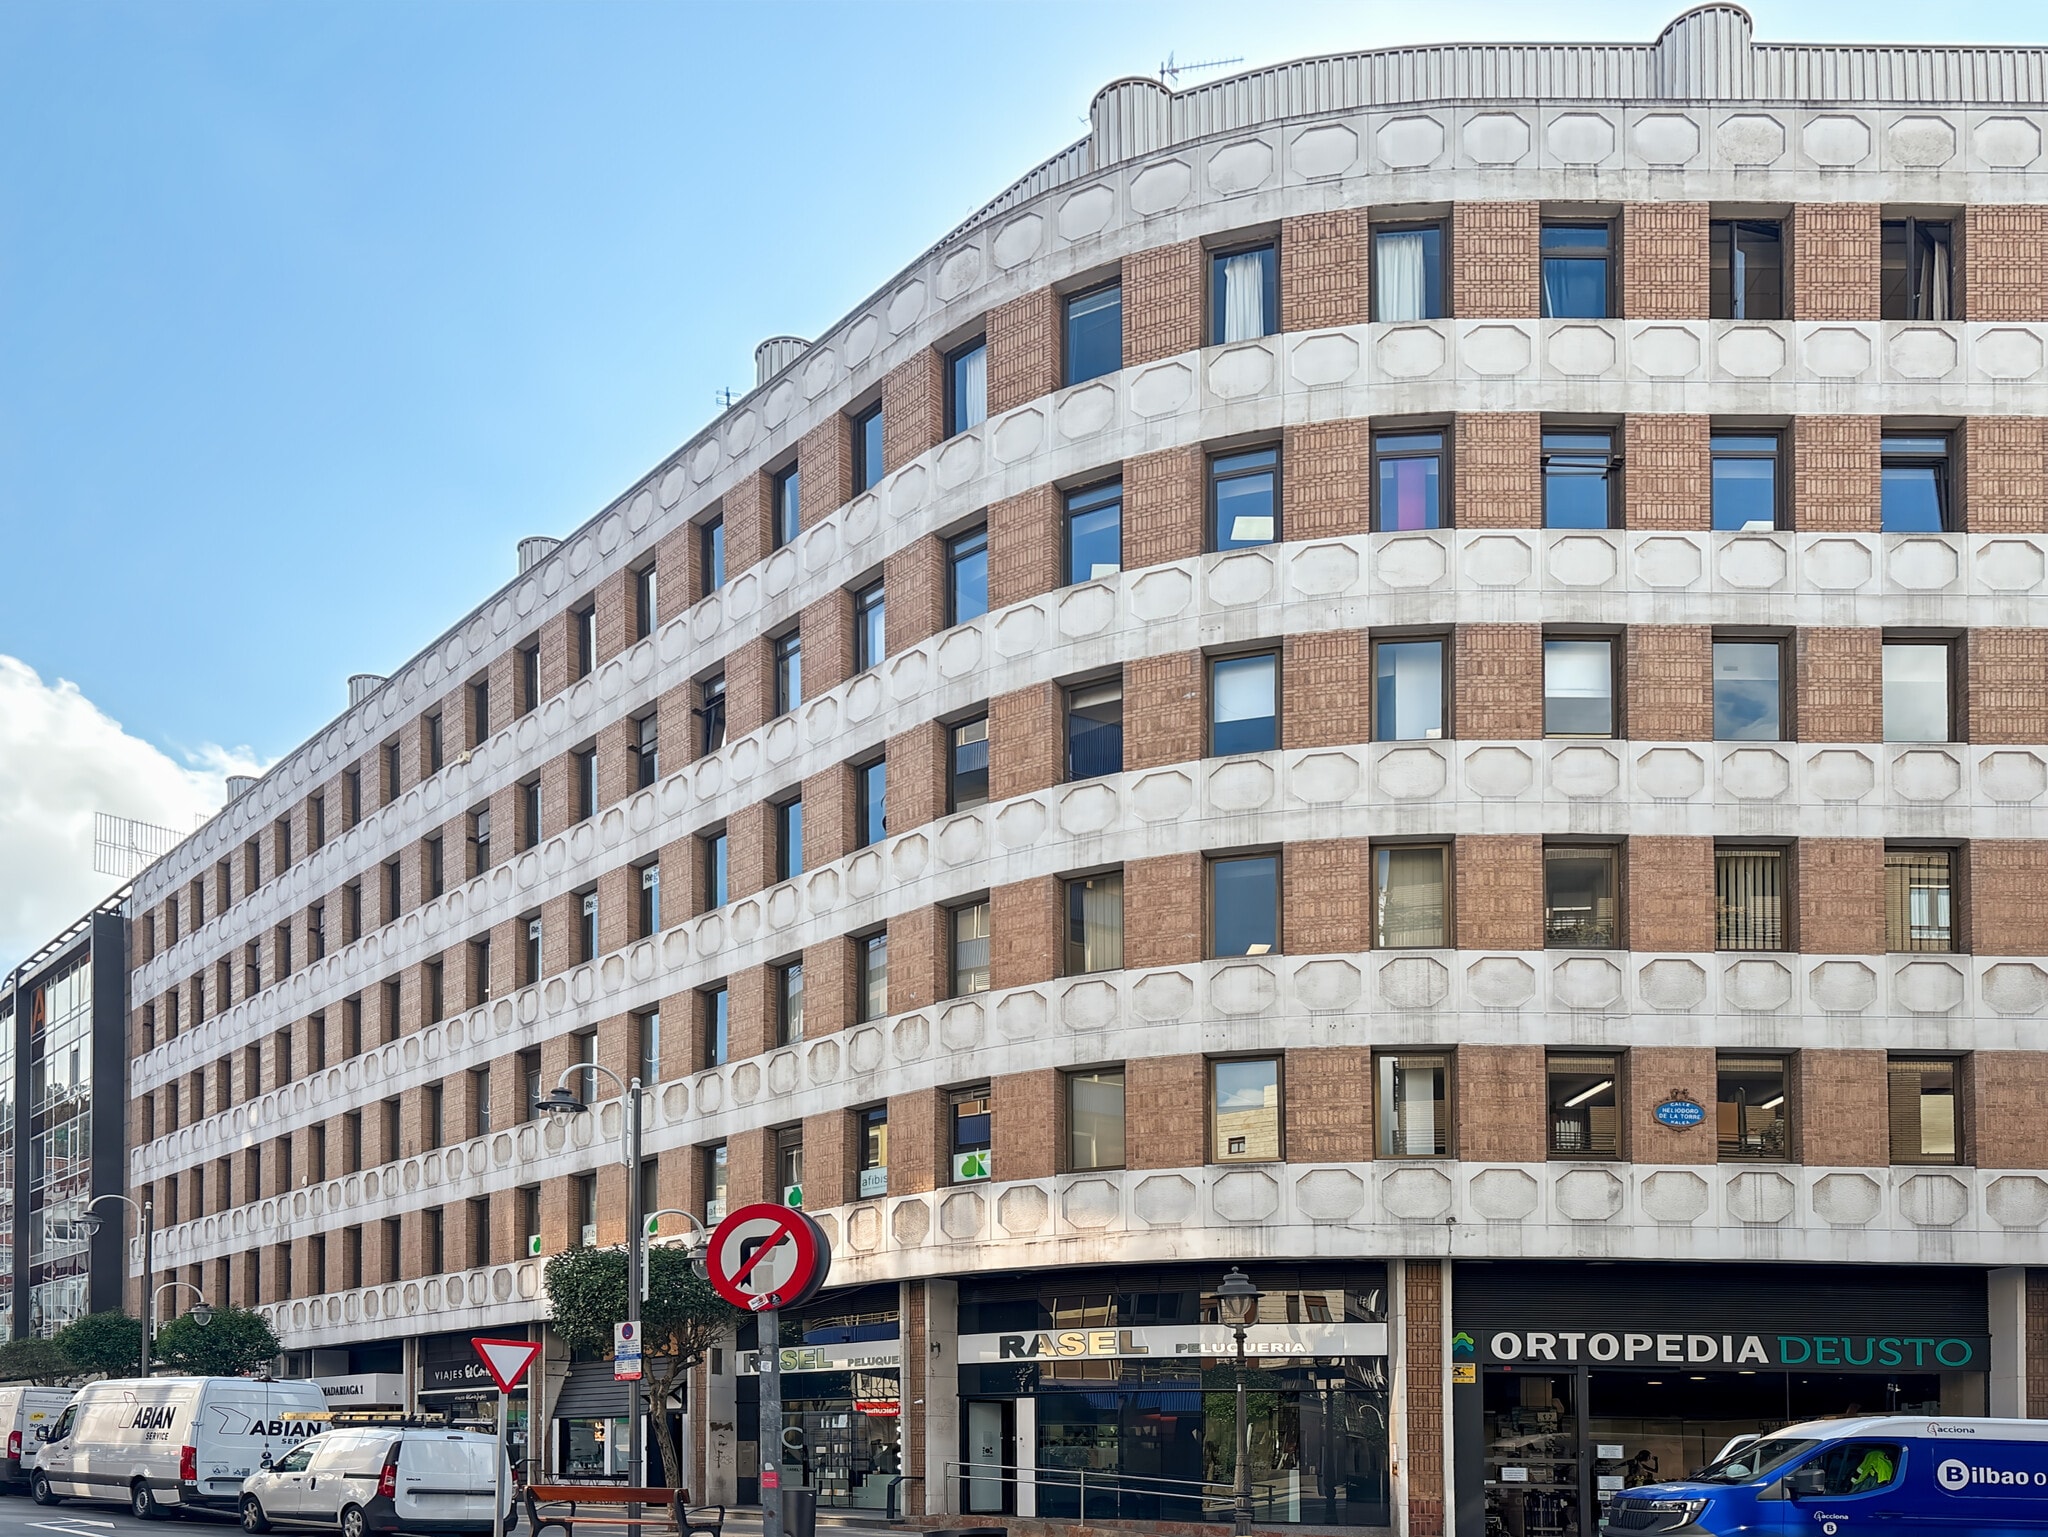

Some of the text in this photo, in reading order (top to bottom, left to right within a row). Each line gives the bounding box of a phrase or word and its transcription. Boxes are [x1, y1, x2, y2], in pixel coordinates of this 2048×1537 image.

[1000, 1330, 1149, 1359] RASEL
[1490, 1331, 1973, 1367] ORTOPEDIA DEUSTO
[744, 1348, 833, 1373] RSEL
[434, 1369, 463, 1381] VIAJES
[132, 1406, 177, 1429] ABIAN
[249, 1419, 322, 1438] ABIAN
[145, 1431, 169, 1441] SERVICE
[1937, 1424, 1976, 1434] acciona
[1943, 1464, 2029, 1486] Bilbao
